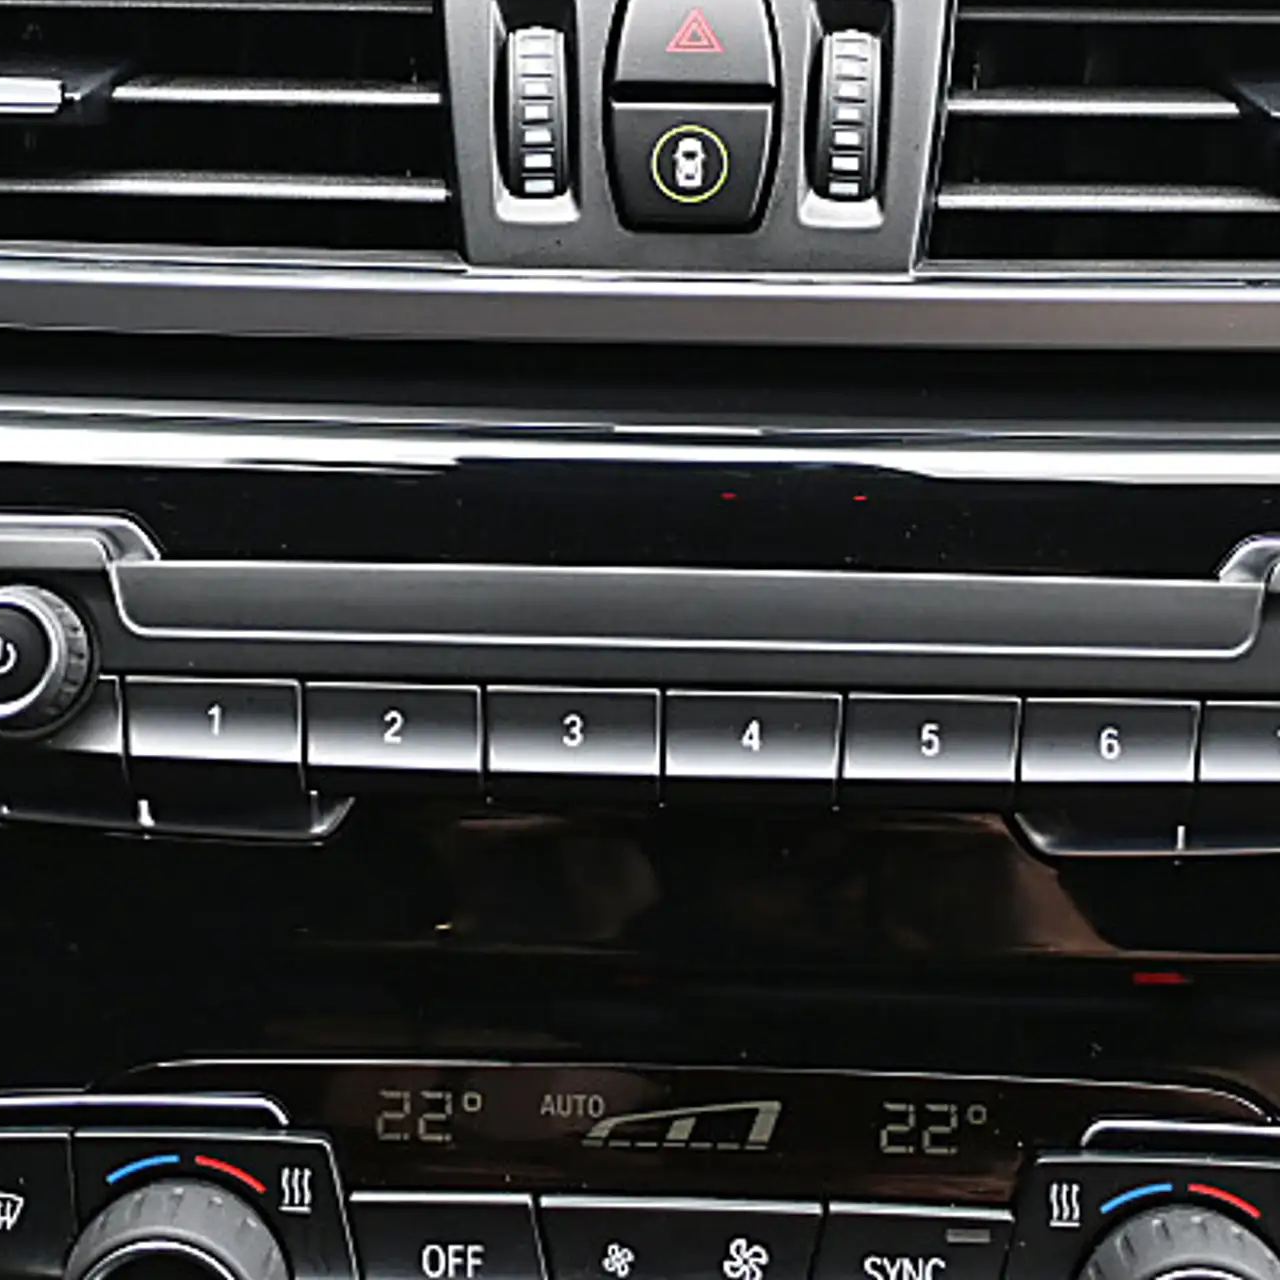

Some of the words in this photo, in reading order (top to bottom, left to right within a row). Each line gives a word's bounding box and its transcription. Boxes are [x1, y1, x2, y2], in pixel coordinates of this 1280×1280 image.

[205, 705, 223, 738] 1
[381, 711, 404, 744] 2
[561, 714, 585, 748] 3
[739, 720, 762, 753] 4
[920, 724, 941, 758] 5
[1099, 728, 1120, 760] 6
[541, 1095, 604, 1117] AUTO
[423, 1245, 482, 1278] OFF
[864, 1257, 945, 1280] SYNC
